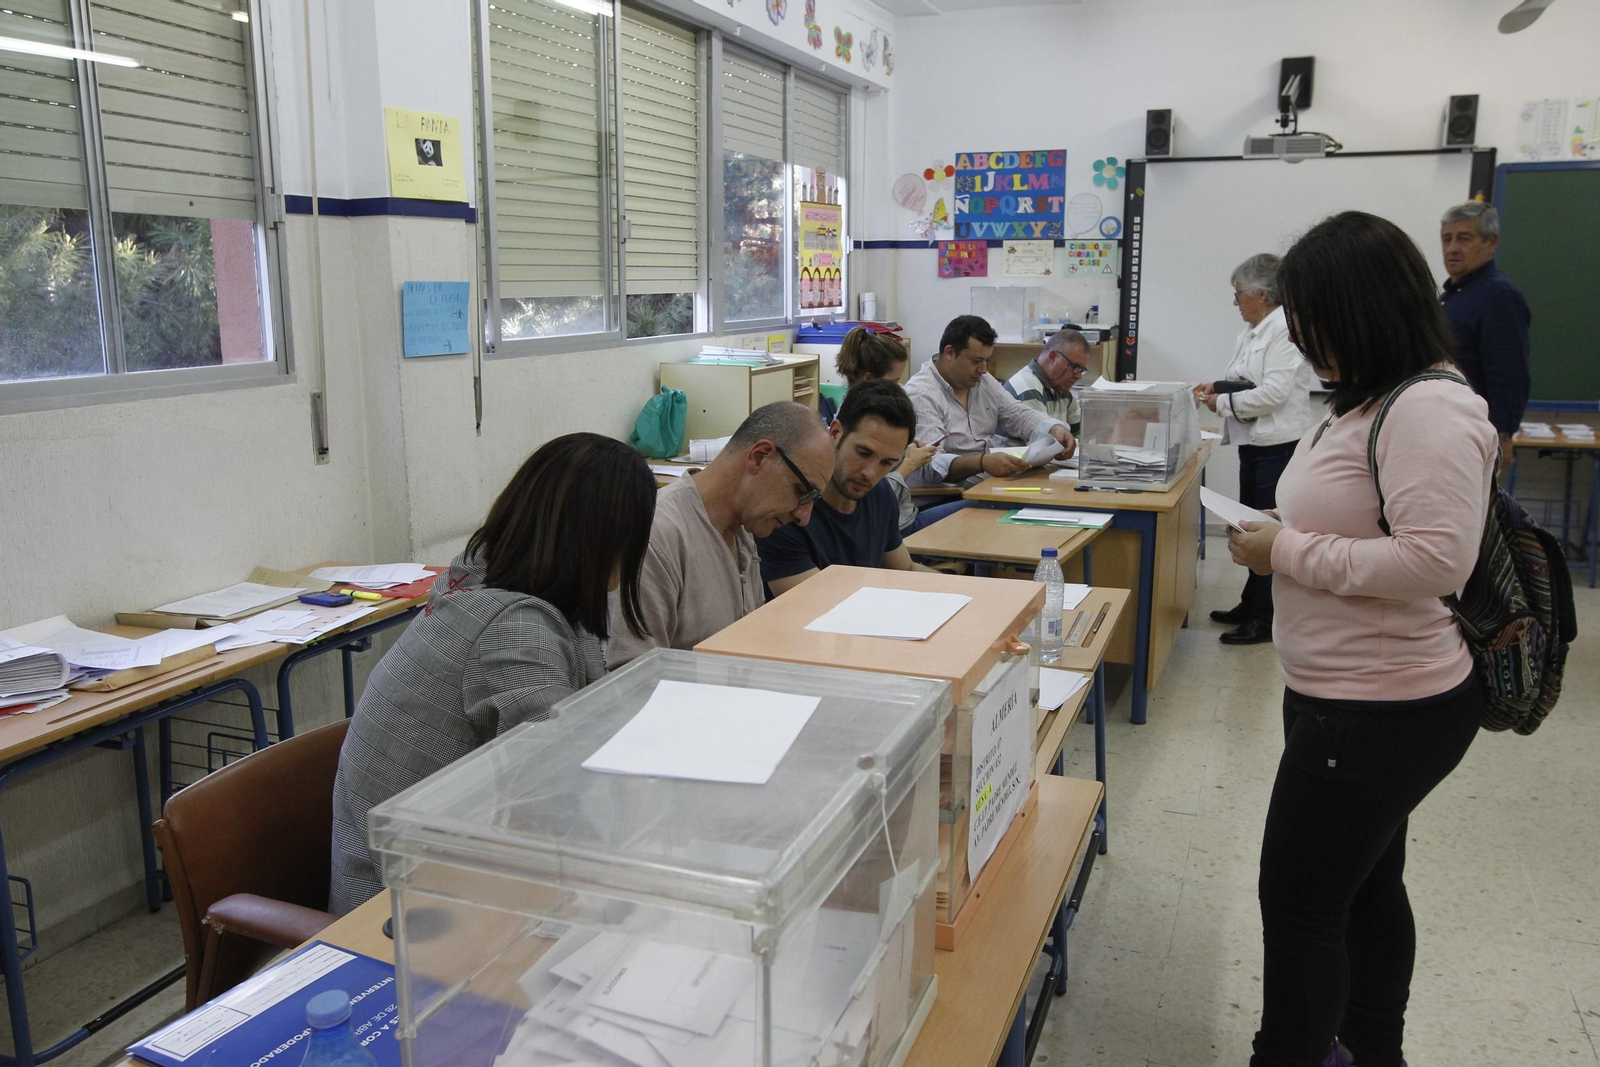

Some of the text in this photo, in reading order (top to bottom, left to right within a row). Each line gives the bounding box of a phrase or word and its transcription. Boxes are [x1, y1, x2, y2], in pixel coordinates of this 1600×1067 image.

[990, 688, 1018, 736] ALMERÍA
[384, 1004, 398, 1013] 28
[371, 1012, 388, 1022] DE
